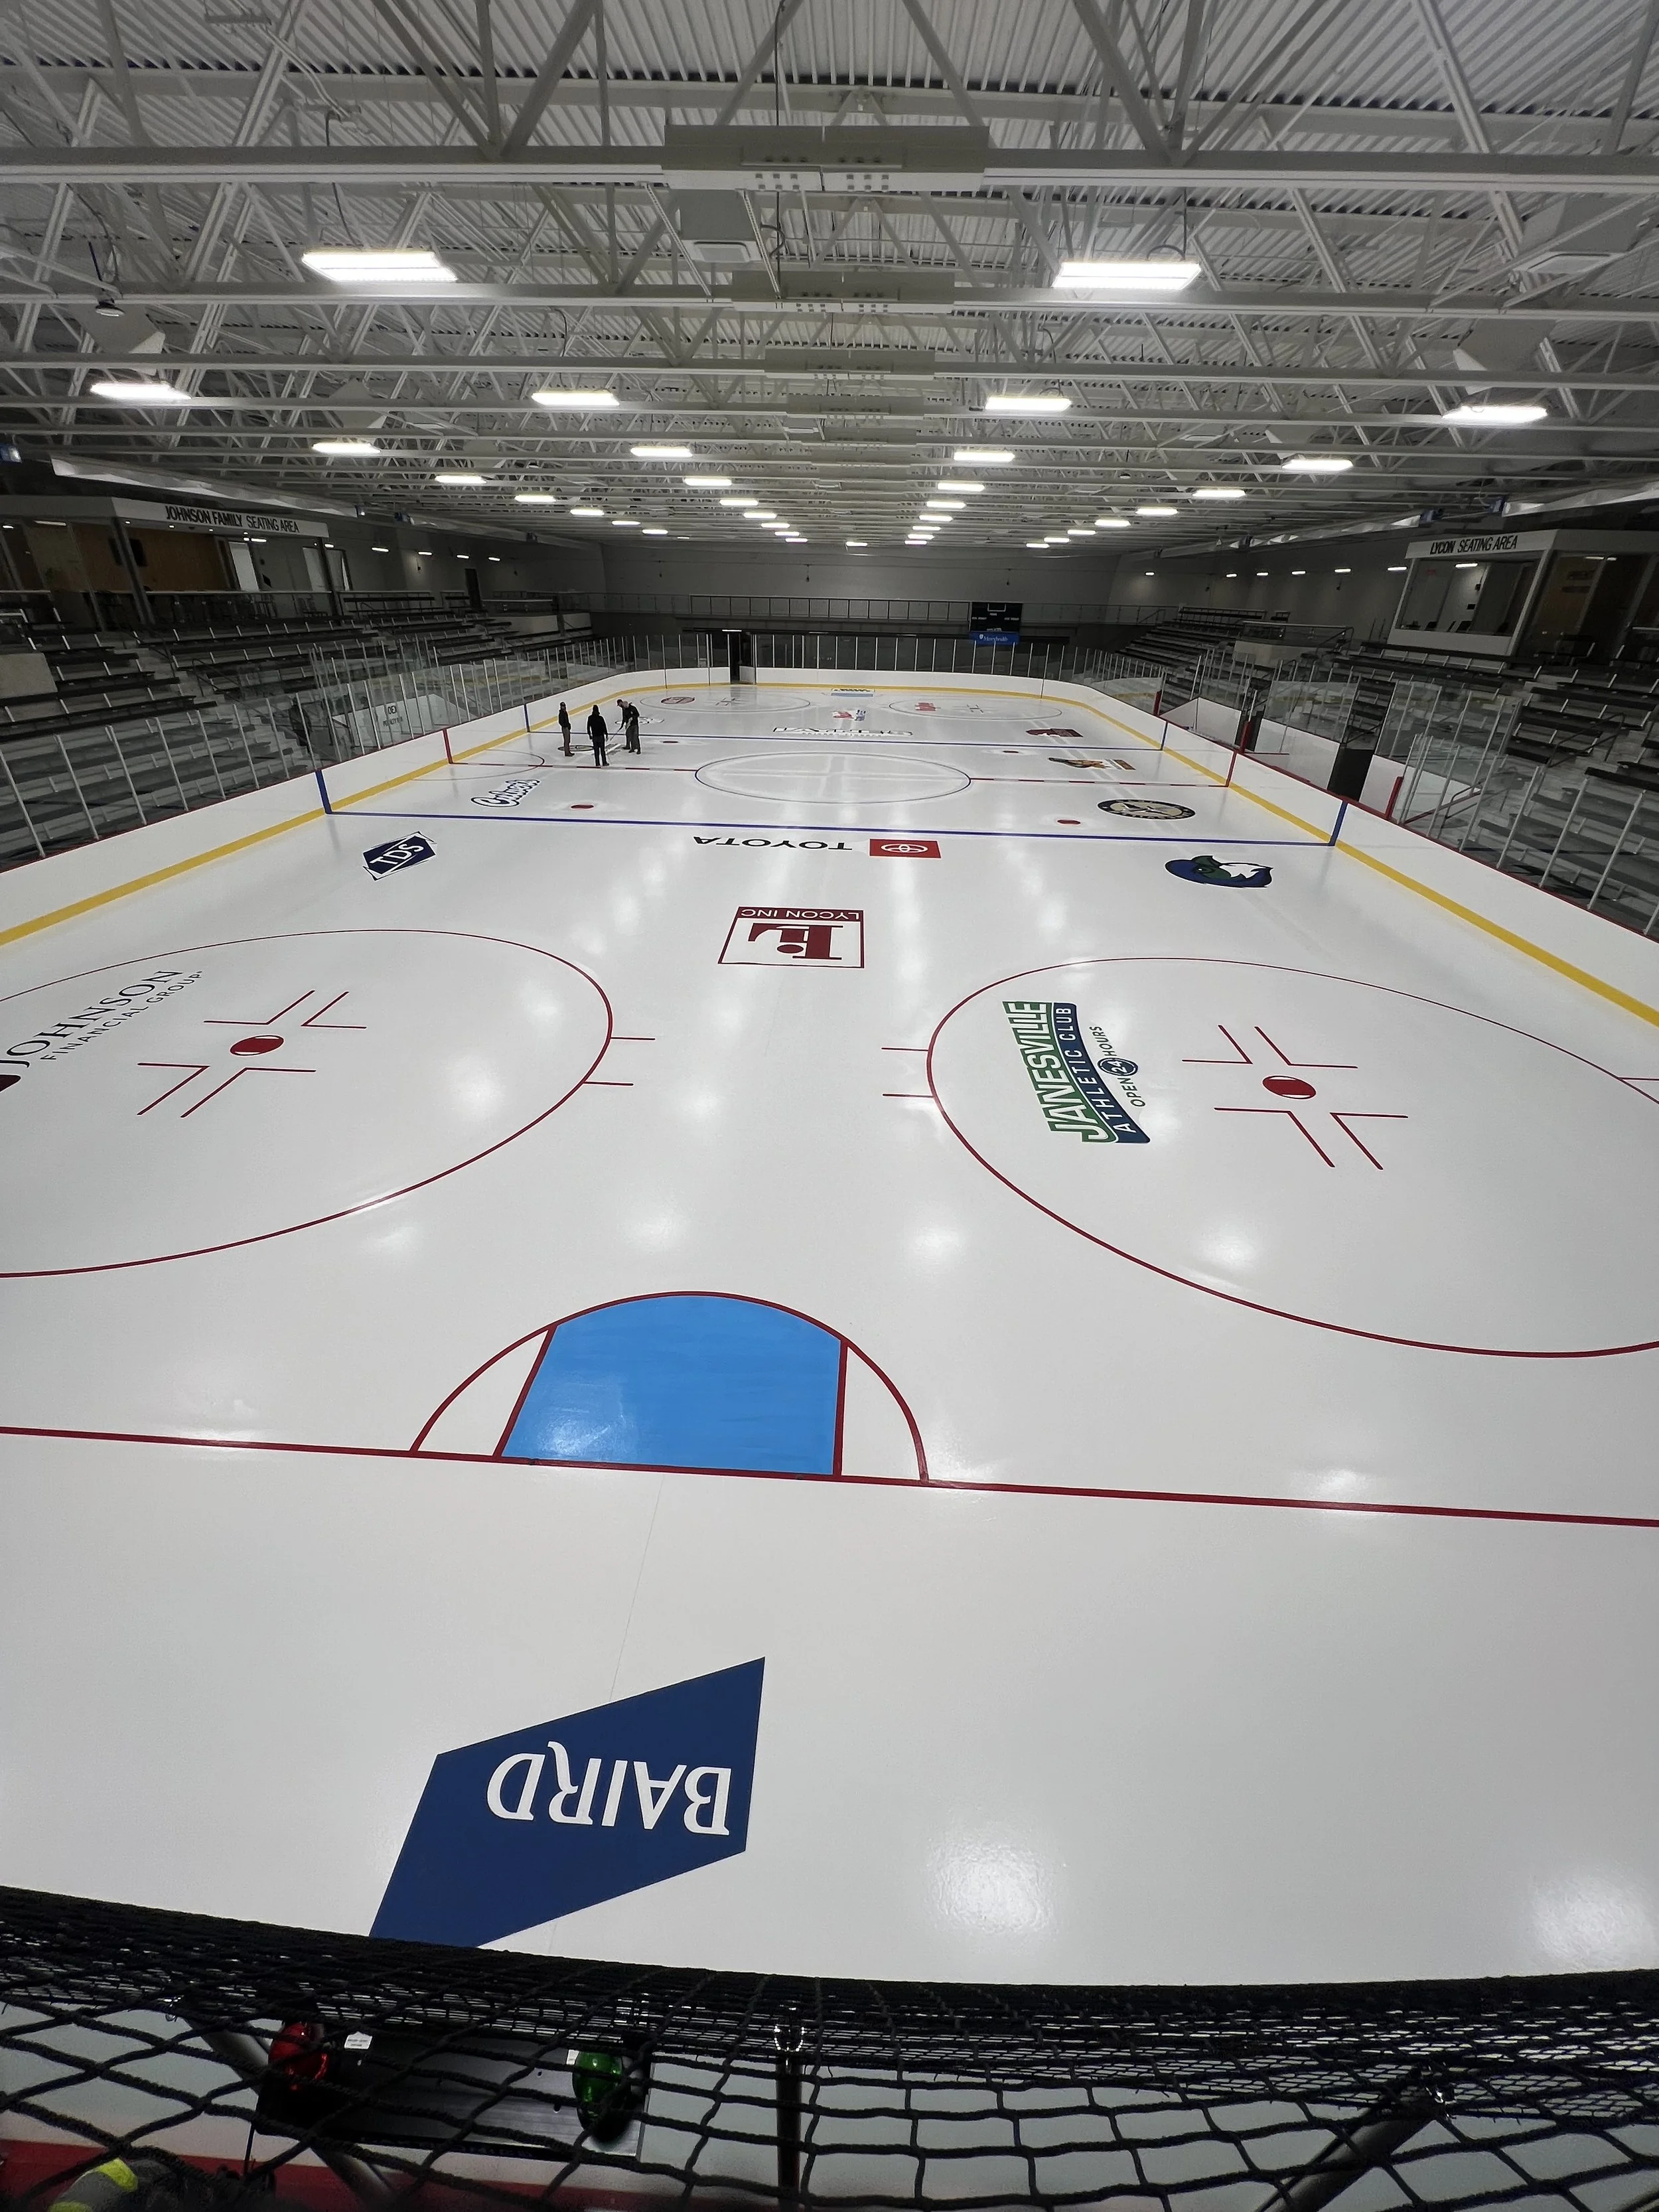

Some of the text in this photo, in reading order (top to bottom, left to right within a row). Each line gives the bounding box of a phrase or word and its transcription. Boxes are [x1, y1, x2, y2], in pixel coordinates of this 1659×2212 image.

[165, 505, 300, 533] JOHNSON FAMILY SEATING AREA
[1430, 535, 1518, 555] LYCON SEATING AREA
[369, 843, 425, 865] TDS
[693, 836, 853, 851] TOYOTA
[741, 909, 860, 921] LYCON INC
[40, 1006, 149, 1061] FINANCIAL
[1005, 1001, 1110, 1140] JANESVILLE
[1055, 1007, 1137, 1134] ATHLETIC CLUB
[1089, 1026, 1146, 1108] OPEN 24 HOURS
[486, 1740, 732, 1836] BAIRD
